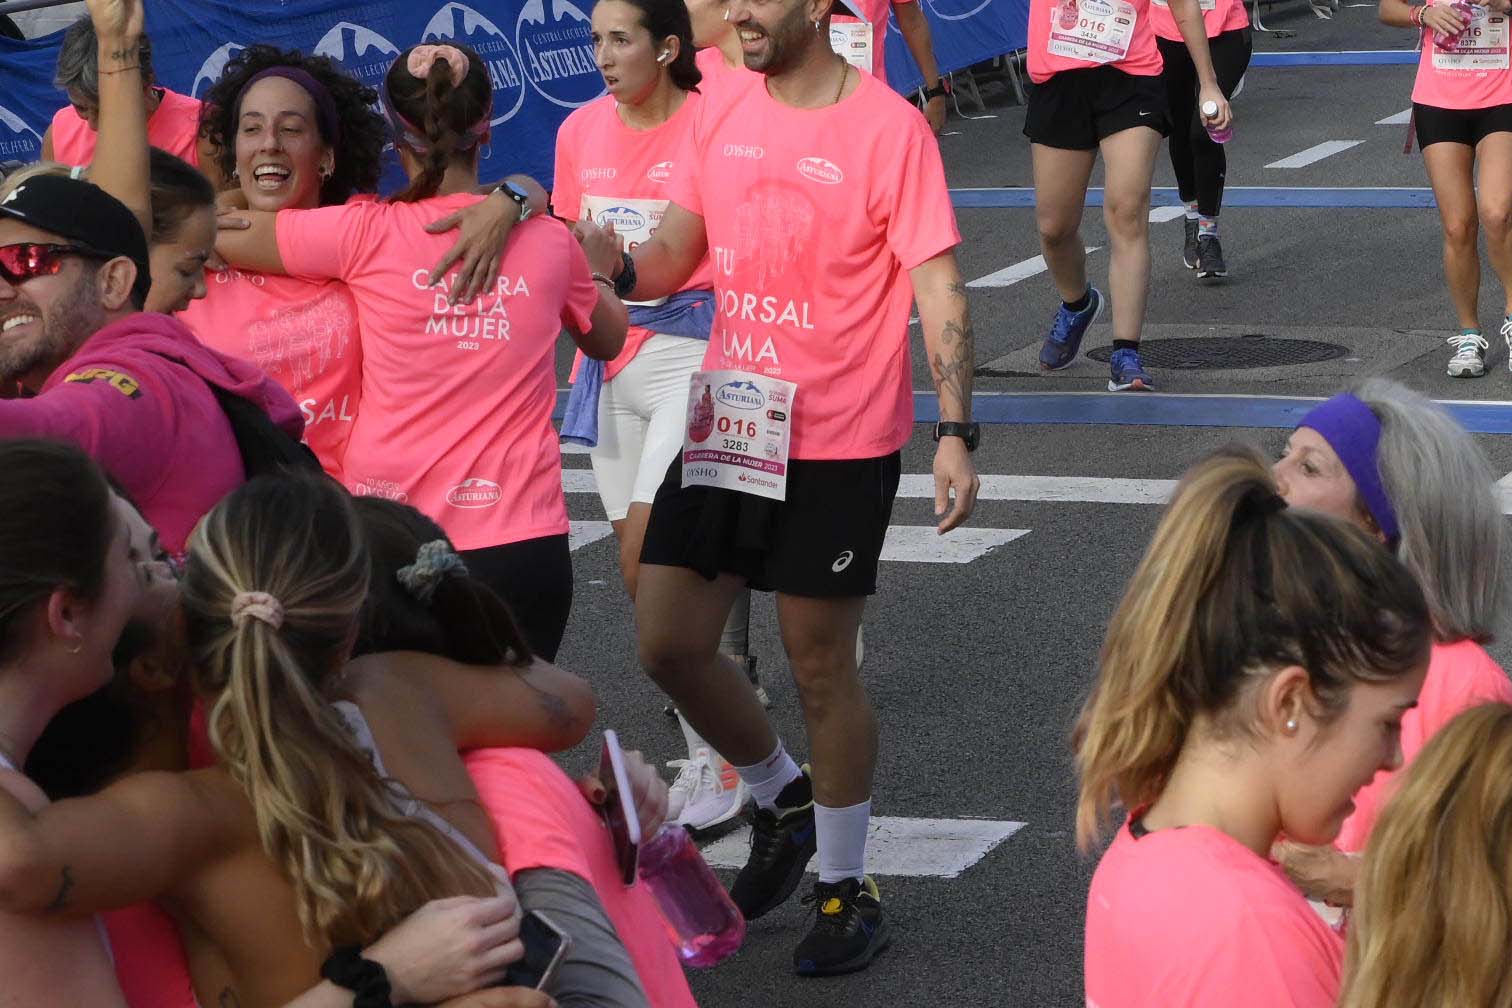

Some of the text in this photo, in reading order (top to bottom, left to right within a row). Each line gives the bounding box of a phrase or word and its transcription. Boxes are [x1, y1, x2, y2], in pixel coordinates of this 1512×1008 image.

[1080, 19, 1105, 33] 016
[1464, 27, 1482, 37] 16
[532, 32, 560, 45] CENTRAL
[1081, 31, 1097, 40] 3434
[0, 139, 35, 154] ECHERA
[715, 247, 735, 276] TU
[411, 268, 530, 296] CARA
[434, 294, 506, 317] DE LA
[719, 288, 815, 329] ORSAL
[425, 316, 511, 340] MUJER
[457, 341, 480, 350] 2023
[719, 390, 762, 405] ASTURIANA
[717, 416, 757, 438] 016
[722, 438, 749, 452] 3283
[732, 455, 742, 464] LA
[742, 457, 762, 467] MUJER
[746, 475, 778, 488] Santander
